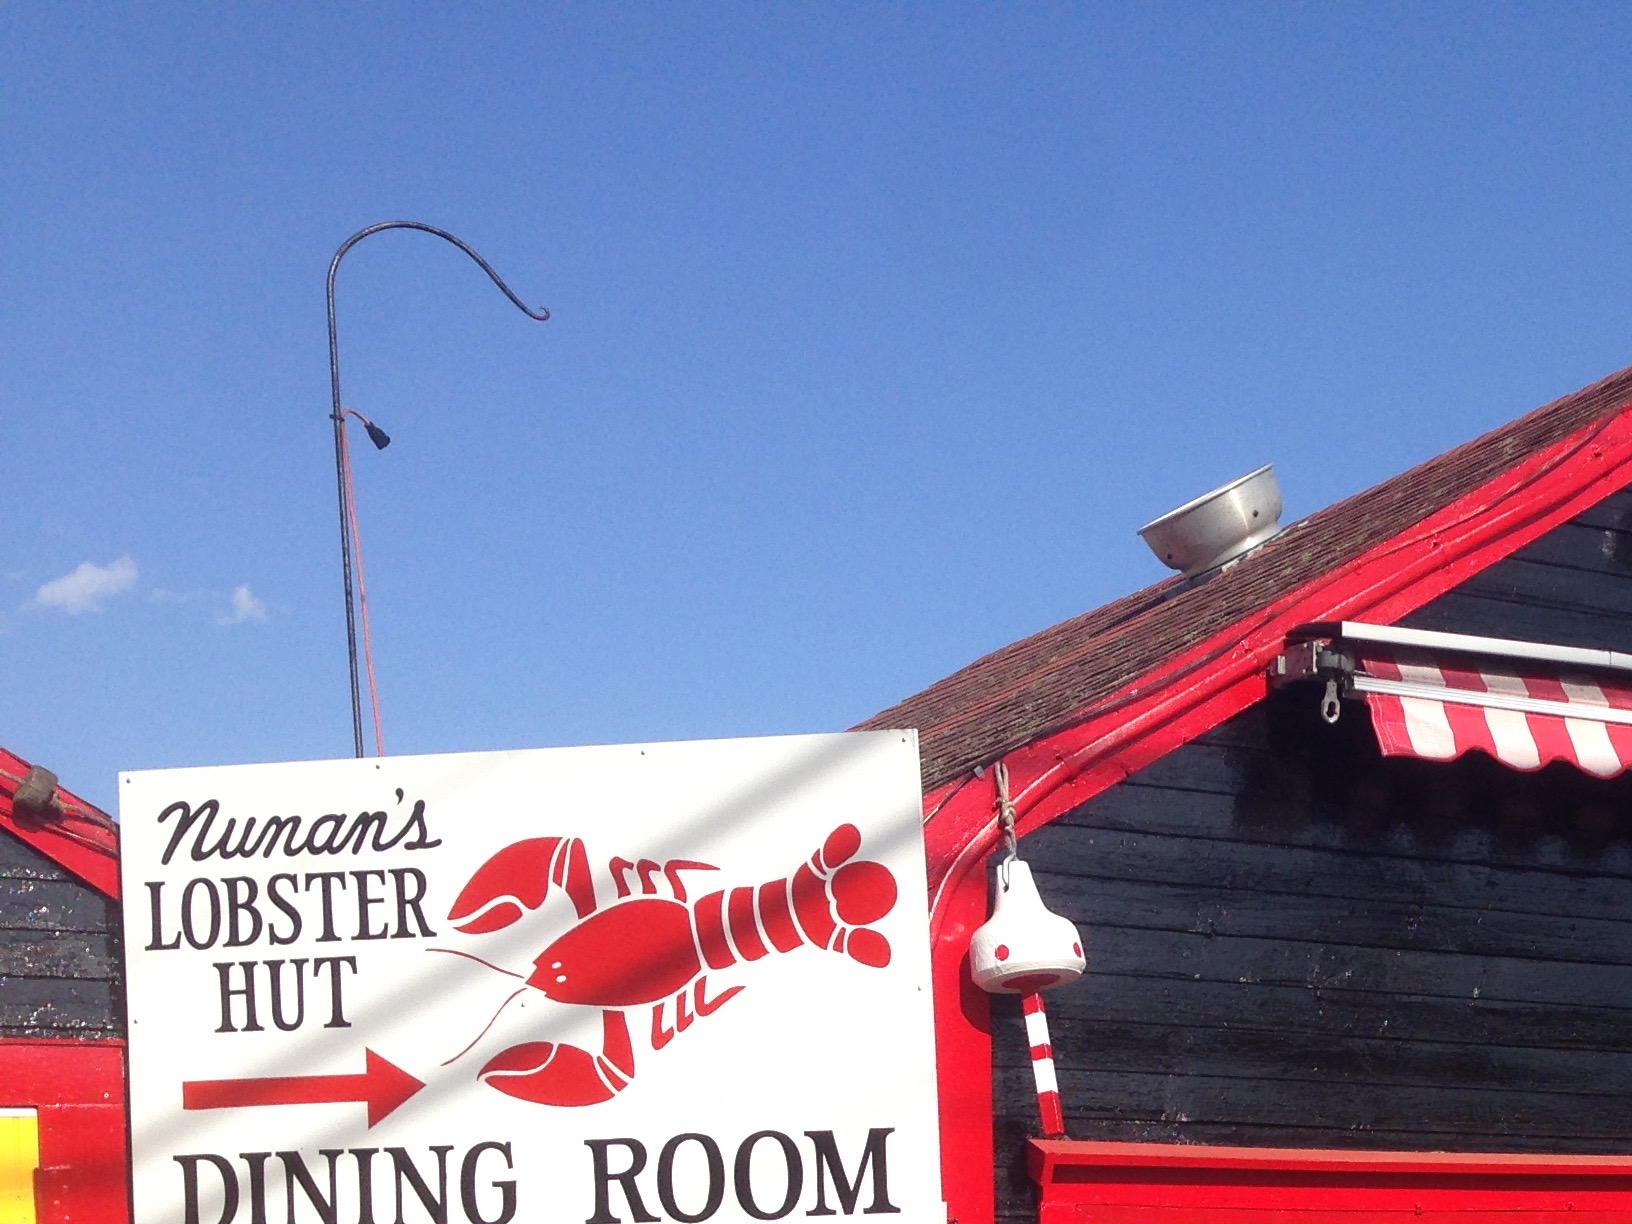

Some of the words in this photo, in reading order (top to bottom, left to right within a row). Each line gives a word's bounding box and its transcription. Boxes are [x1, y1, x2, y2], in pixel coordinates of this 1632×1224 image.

[157, 787, 442, 866] Nunan's
[144, 867, 437, 951] LOBSTER
[212, 955, 358, 1033] HUT
